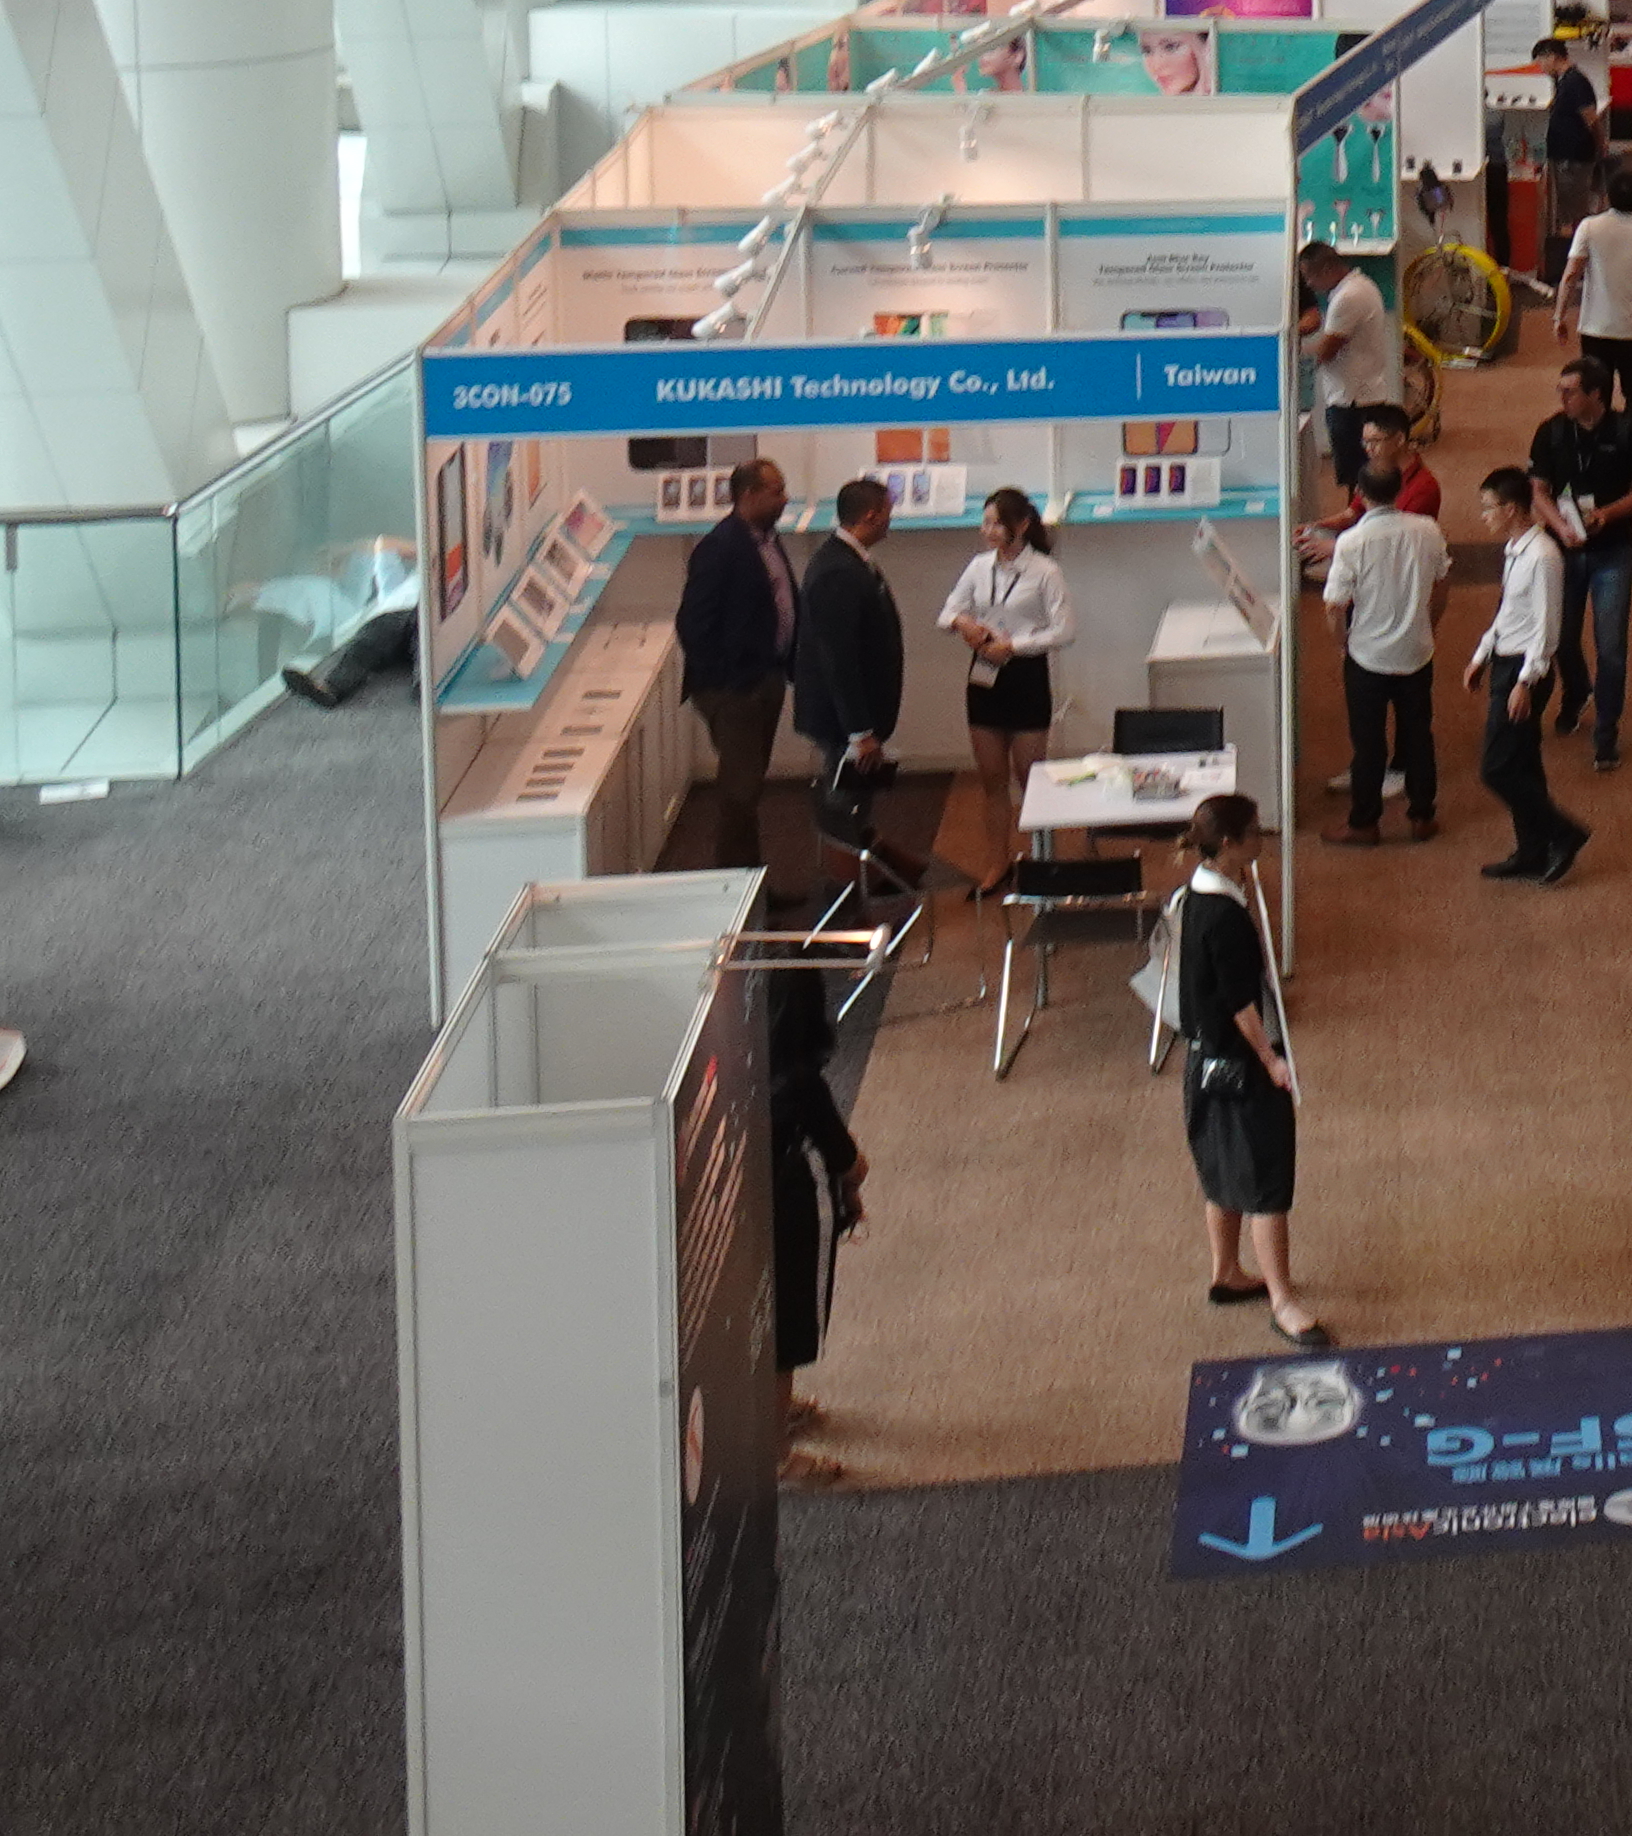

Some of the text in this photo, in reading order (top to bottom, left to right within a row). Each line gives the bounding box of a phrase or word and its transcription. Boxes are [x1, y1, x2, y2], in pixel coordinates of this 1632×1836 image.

[453, 363, 1257, 410] 3CON-075 KUKASHI Technology Co., Ltd. Taiwan
